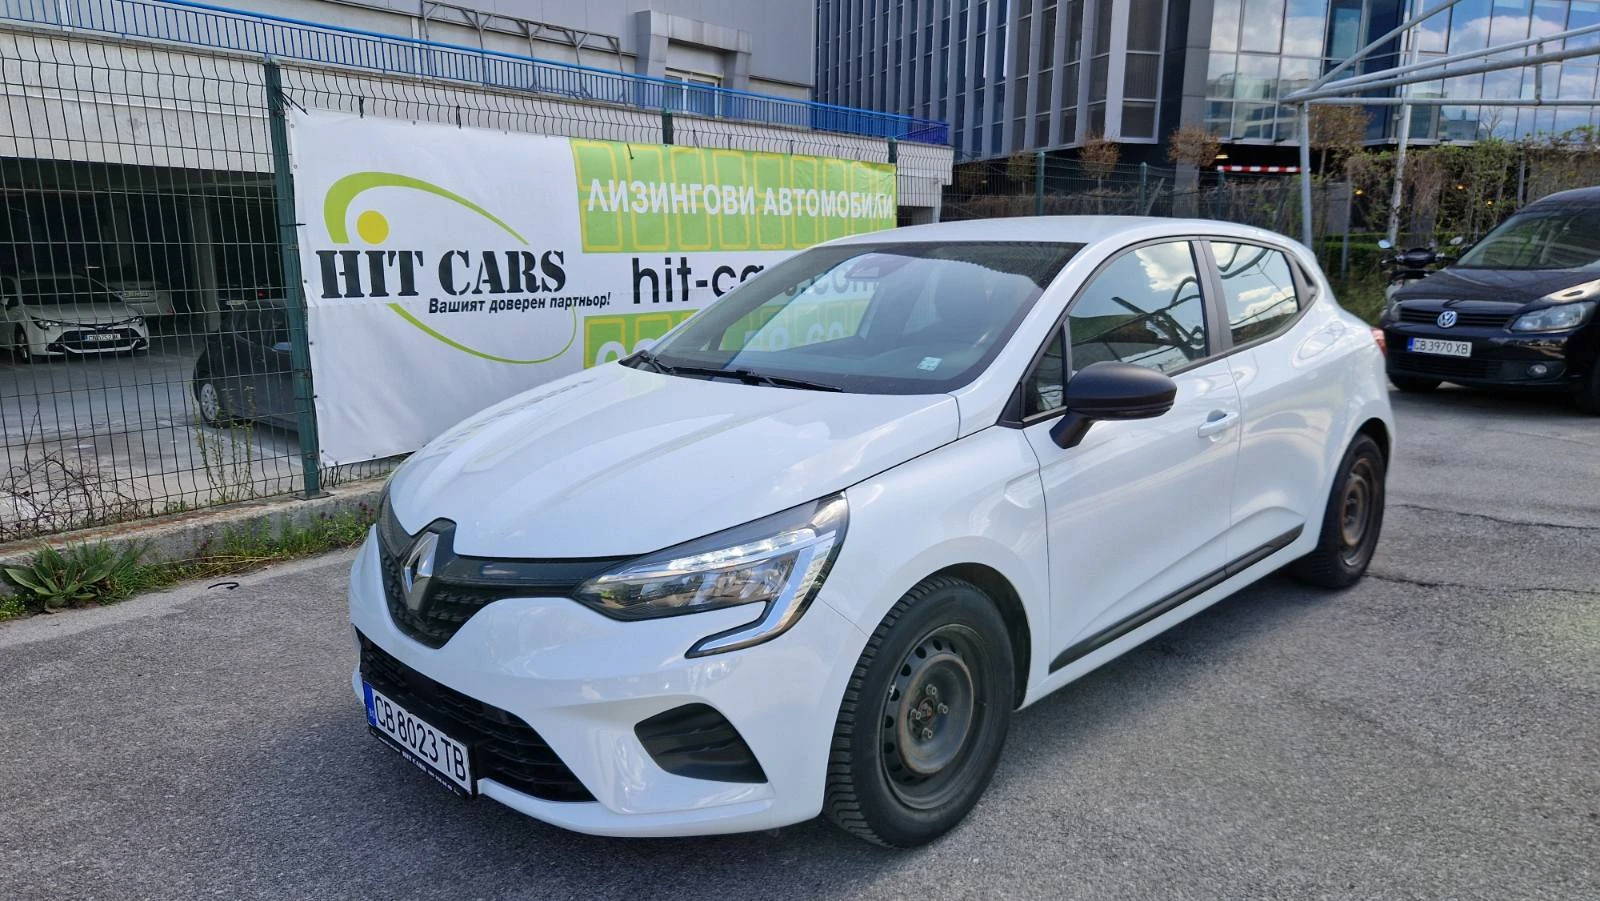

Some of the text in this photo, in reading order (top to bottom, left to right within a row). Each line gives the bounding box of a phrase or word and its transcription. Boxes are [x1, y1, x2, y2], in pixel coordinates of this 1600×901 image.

[587, 177, 893, 220] ЛИЗИНГОВИ АВТОМОБИЛИ
[315, 249, 567, 299] HIT CARS
[428, 291, 611, 314] Вашият доверен партньор!
[1415, 339, 1426, 351] CB
[1427, 341, 1453, 353] 3970
[1454, 343, 1468, 355] XB
[375, 695, 396, 734] CB
[397, 710, 439, 763] 8023
[441, 736, 467, 782] TB
